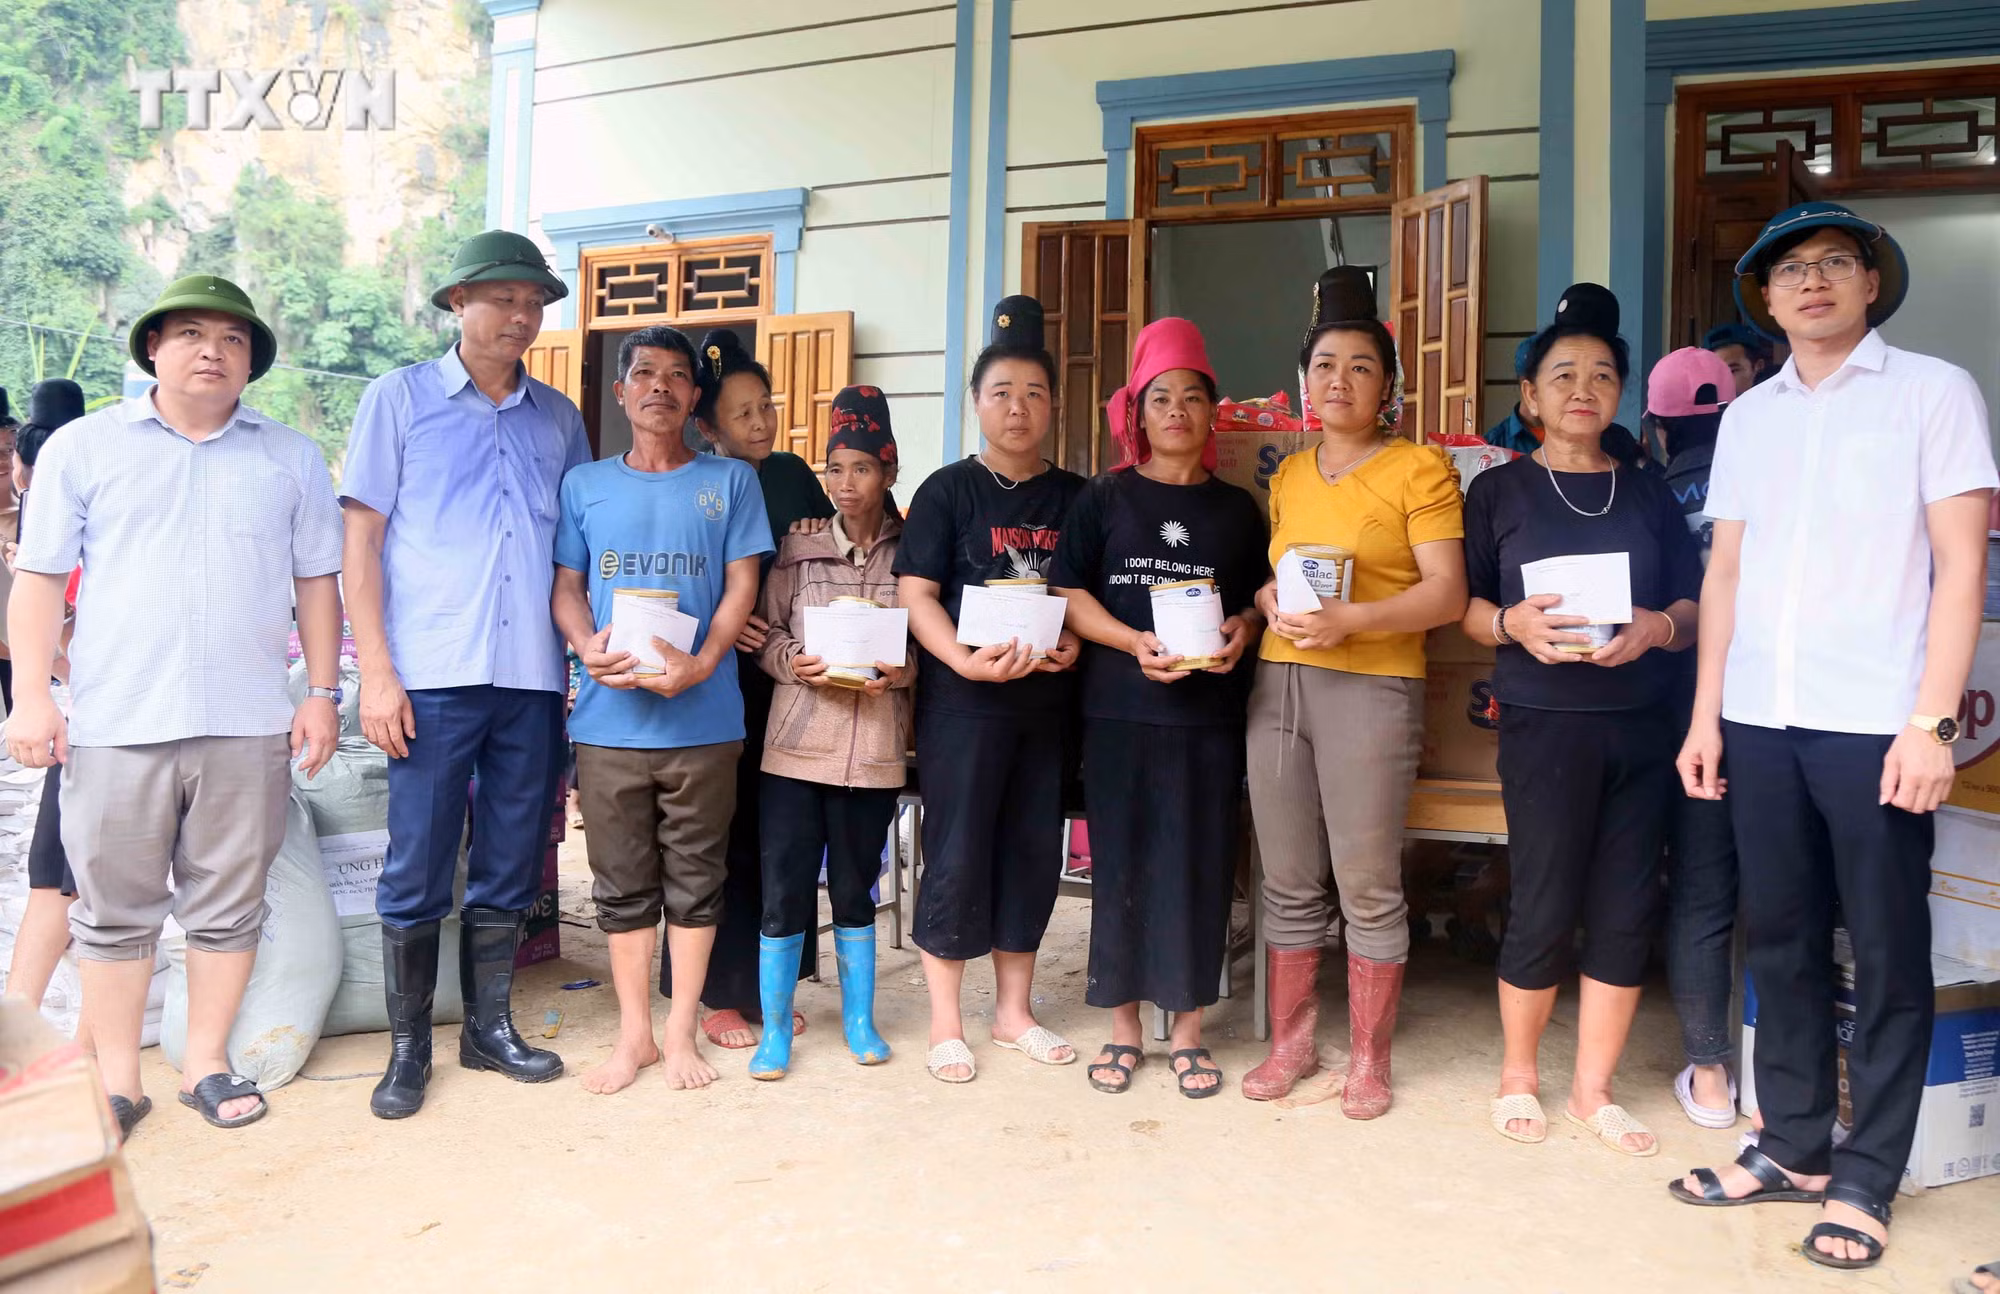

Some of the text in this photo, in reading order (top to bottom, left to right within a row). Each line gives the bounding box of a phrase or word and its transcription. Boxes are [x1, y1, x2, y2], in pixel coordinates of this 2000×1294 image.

[699, 490, 723, 512] BVB
[991, 527, 1031, 557] MAISON
[622, 551, 707, 577] EVONIK
[1129, 557, 1153, 568] DONT
[1154, 559, 1191, 574] BELONG
[1193, 565, 1215, 577] HERE
[1302, 569, 1333, 580] nalac
[374, 857, 385, 869] H
